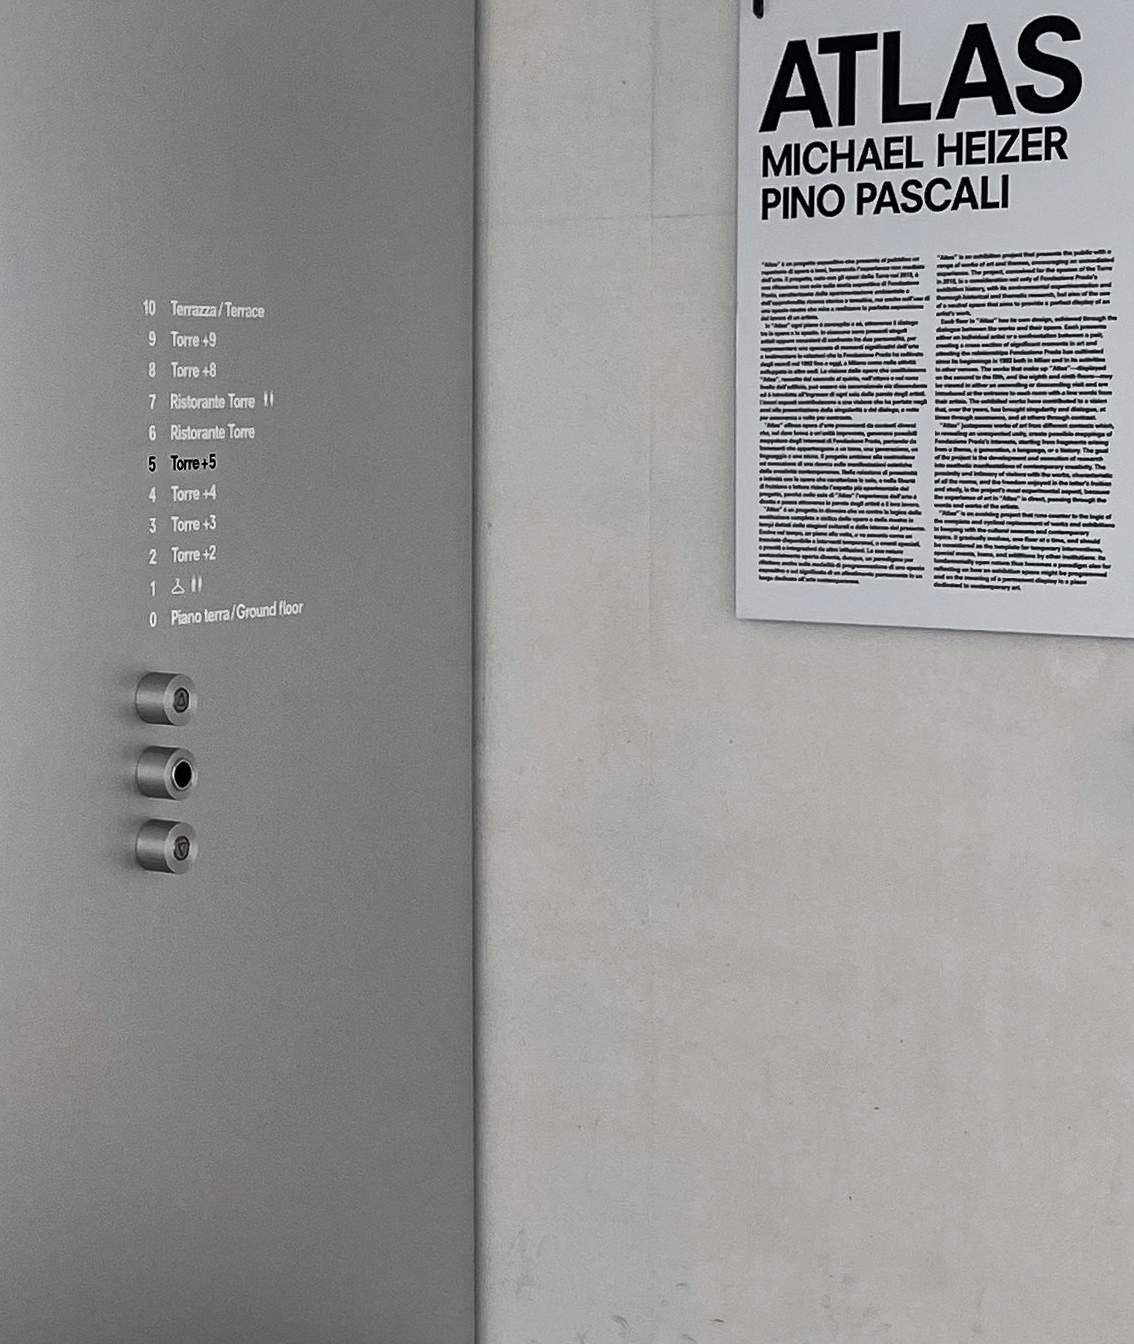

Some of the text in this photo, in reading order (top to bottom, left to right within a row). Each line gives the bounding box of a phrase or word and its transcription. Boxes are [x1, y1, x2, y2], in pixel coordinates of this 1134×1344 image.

[759, 15, 1083, 133] ATLAS
[762, 125, 1069, 178] MICHAEL HEIZER
[762, 174, 1010, 221] PINO PASCALI
[142, 300, 156, 316] 10
[148, 331, 217, 347] 9 Torre +9
[148, 362, 217, 378] 8 Torre +8
[148, 393, 255, 409] 7 Ristorante Torre
[148, 423, 255, 441] 6 Ristorante Torre
[148, 454, 217, 472] 5 Torre +5
[148, 484, 217, 503] 4 Torre +4
[148, 515, 217, 533] 3 Torre +3
[148, 545, 217, 565] 2 Torre +2
[149, 580, 156, 596] 1
[149, 612, 157, 628] 0
[171, 609, 202, 625] Piano
[278, 599, 304, 616] floor
